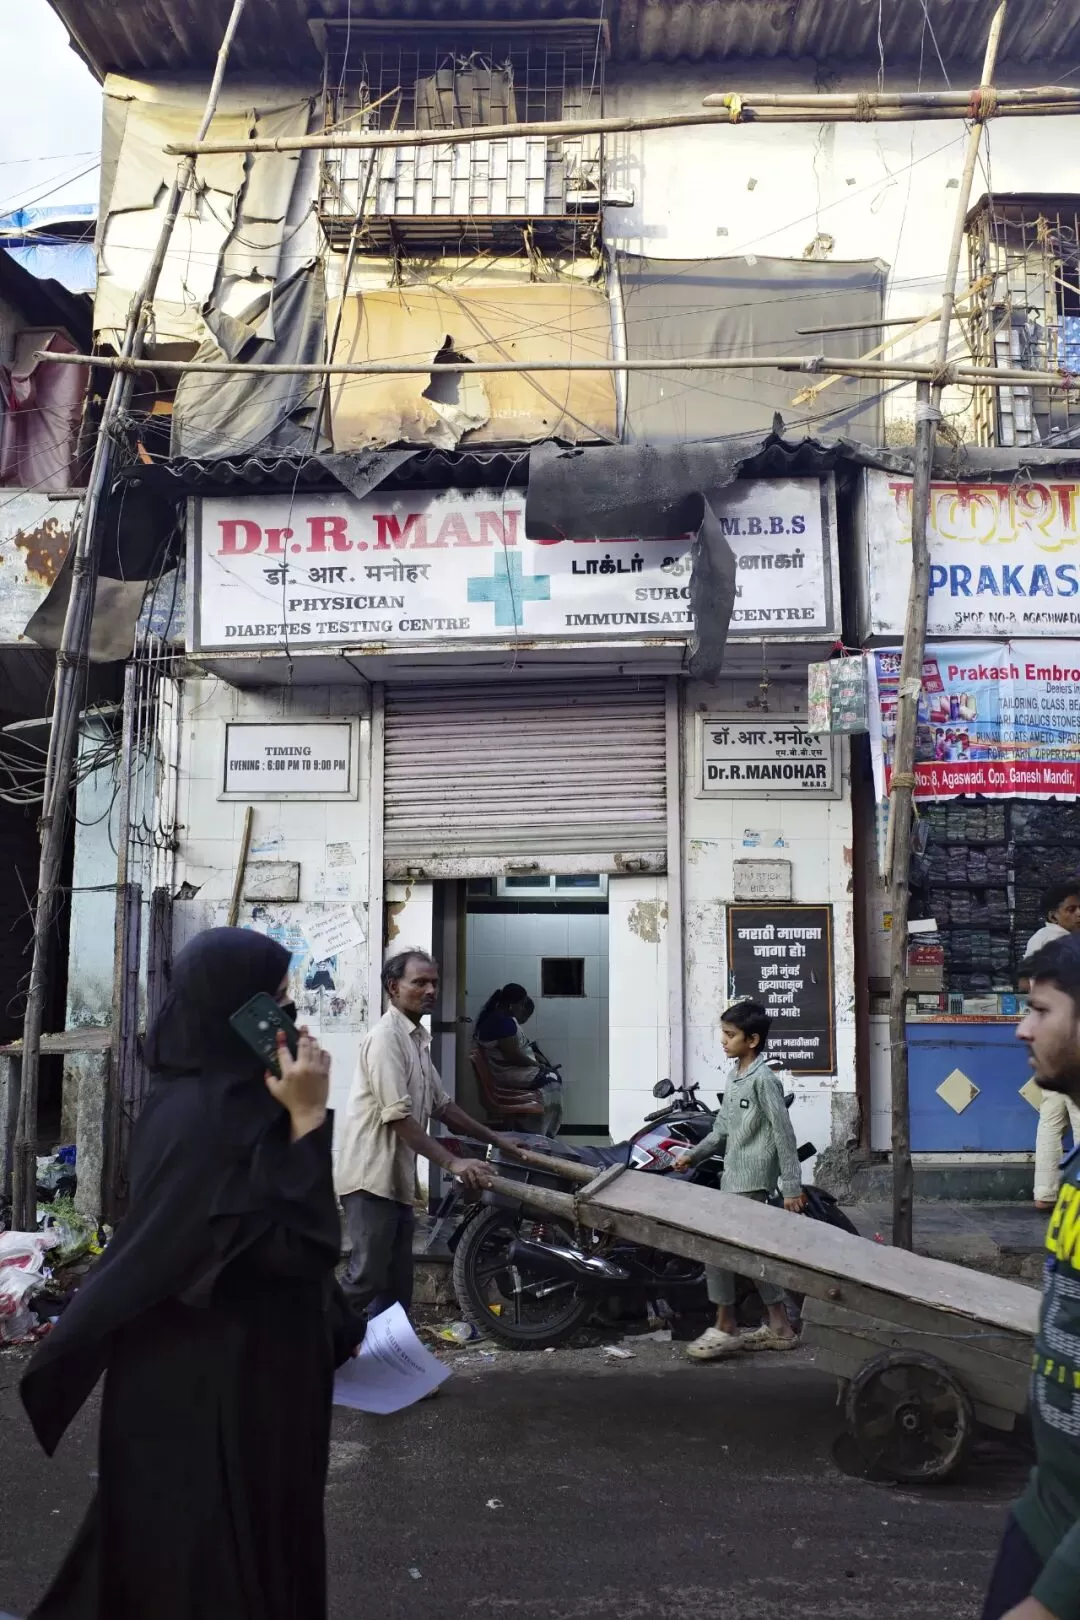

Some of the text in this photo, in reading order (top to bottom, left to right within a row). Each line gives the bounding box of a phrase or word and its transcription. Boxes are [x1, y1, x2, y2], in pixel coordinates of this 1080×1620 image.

[719, 515, 806, 536] M.B.B.S
[364, 557, 432, 583] मनोहर
[928, 564, 1080, 597] PRAKAS
[288, 594, 405, 612] PHYSICIAN
[565, 607, 816, 627] IMMUNISATI CENTRE
[224, 617, 471, 638] DIABETES TESTING CENTRE
[947, 663, 1020, 682] Prakash
[1046, 682, 1073, 694] Dealers
[264, 746, 313, 756] TIMING
[229, 759, 260, 771] EVENING
[287, 759, 300, 771] PM
[301, 759, 312, 771] TO
[333, 759, 346, 771] PM
[941, 770, 987, 789] Agaswadi,
[1009, 767, 1042, 783] Ganesh
[737, 924, 822, 940] मराठी माणसा
[753, 945, 786, 958] जागा
